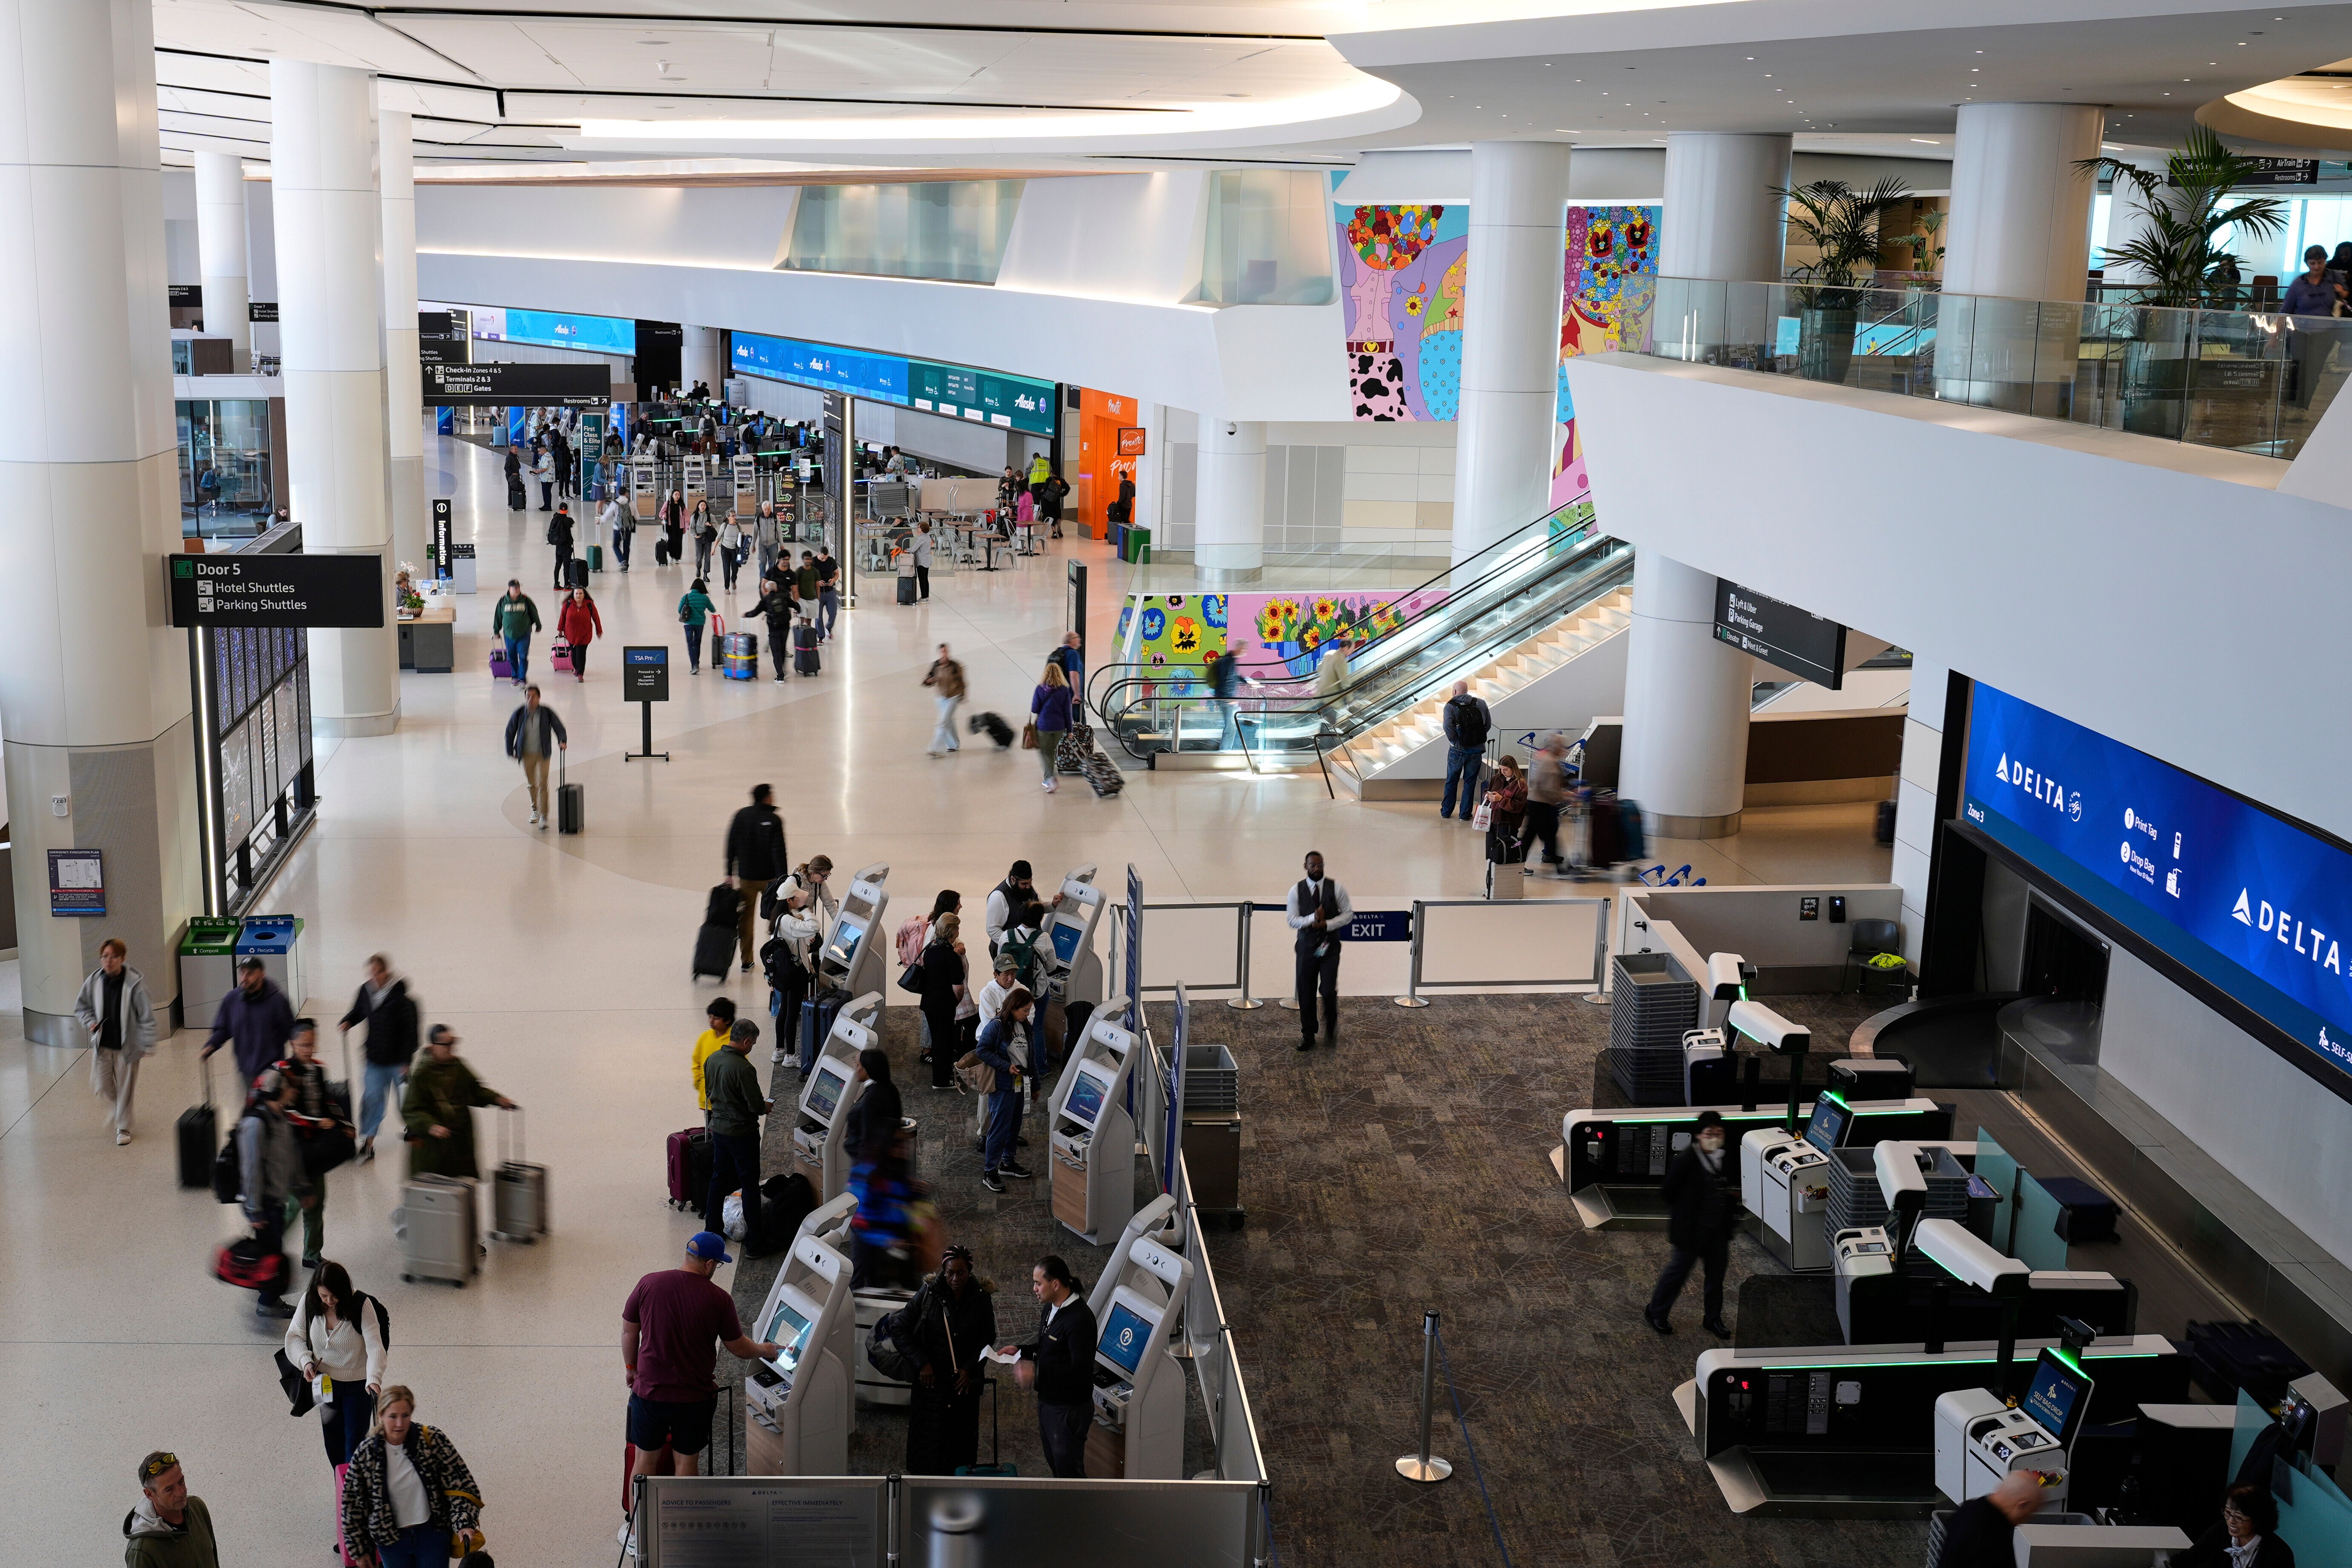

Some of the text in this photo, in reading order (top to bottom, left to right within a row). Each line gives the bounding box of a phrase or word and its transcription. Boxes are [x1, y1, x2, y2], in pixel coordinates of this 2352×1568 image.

[2277, 159, 2295, 168] AirTrain
[554, 324, 569, 335] Alaska
[737, 345, 749, 357] Alaska
[809, 357, 823, 372] Alaska
[1015, 393, 1035, 412] Alaska
[1122, 436, 1143, 449] Pronto!
[1110, 459, 1136, 478] Pron
[439, 520, 447, 565] Information
[197, 563, 241, 575] Door 5
[216, 582, 295, 593] Hotel Shuttles
[217, 599, 307, 612] Parking Shuttles
[1735, 597, 1757, 614] Lyft & Uber
[1735, 612, 1749, 628] Parking
[1749, 618, 1763, 633] Garage
[1727, 631, 1739, 643] Elevator
[1747, 640, 1755, 651] Meet
[1759, 645, 1768, 656] Greet
[2013, 760, 2063, 812] DELTA
[1968, 803, 1984, 823] Zone 3
[2134, 816, 2148, 833] Print
[2148, 823, 2157, 840] Tag
[2131, 850, 2144, 869] Drop
[2144, 857, 2155, 876] Bag
[2145, 874, 2154, 885] Ready
[1351, 924, 1385, 937] EXIT
[2258, 900, 2340, 975] DELTA
[2064, 1381, 2074, 1390] DELTA
[2033, 1391, 2063, 1417] SELF BAG DROP
[2033, 1399, 2042, 1408] TOUCH
[2041, 1405, 2050, 1416] SCREEN
[2053, 1415, 2062, 1424] BEGIN
